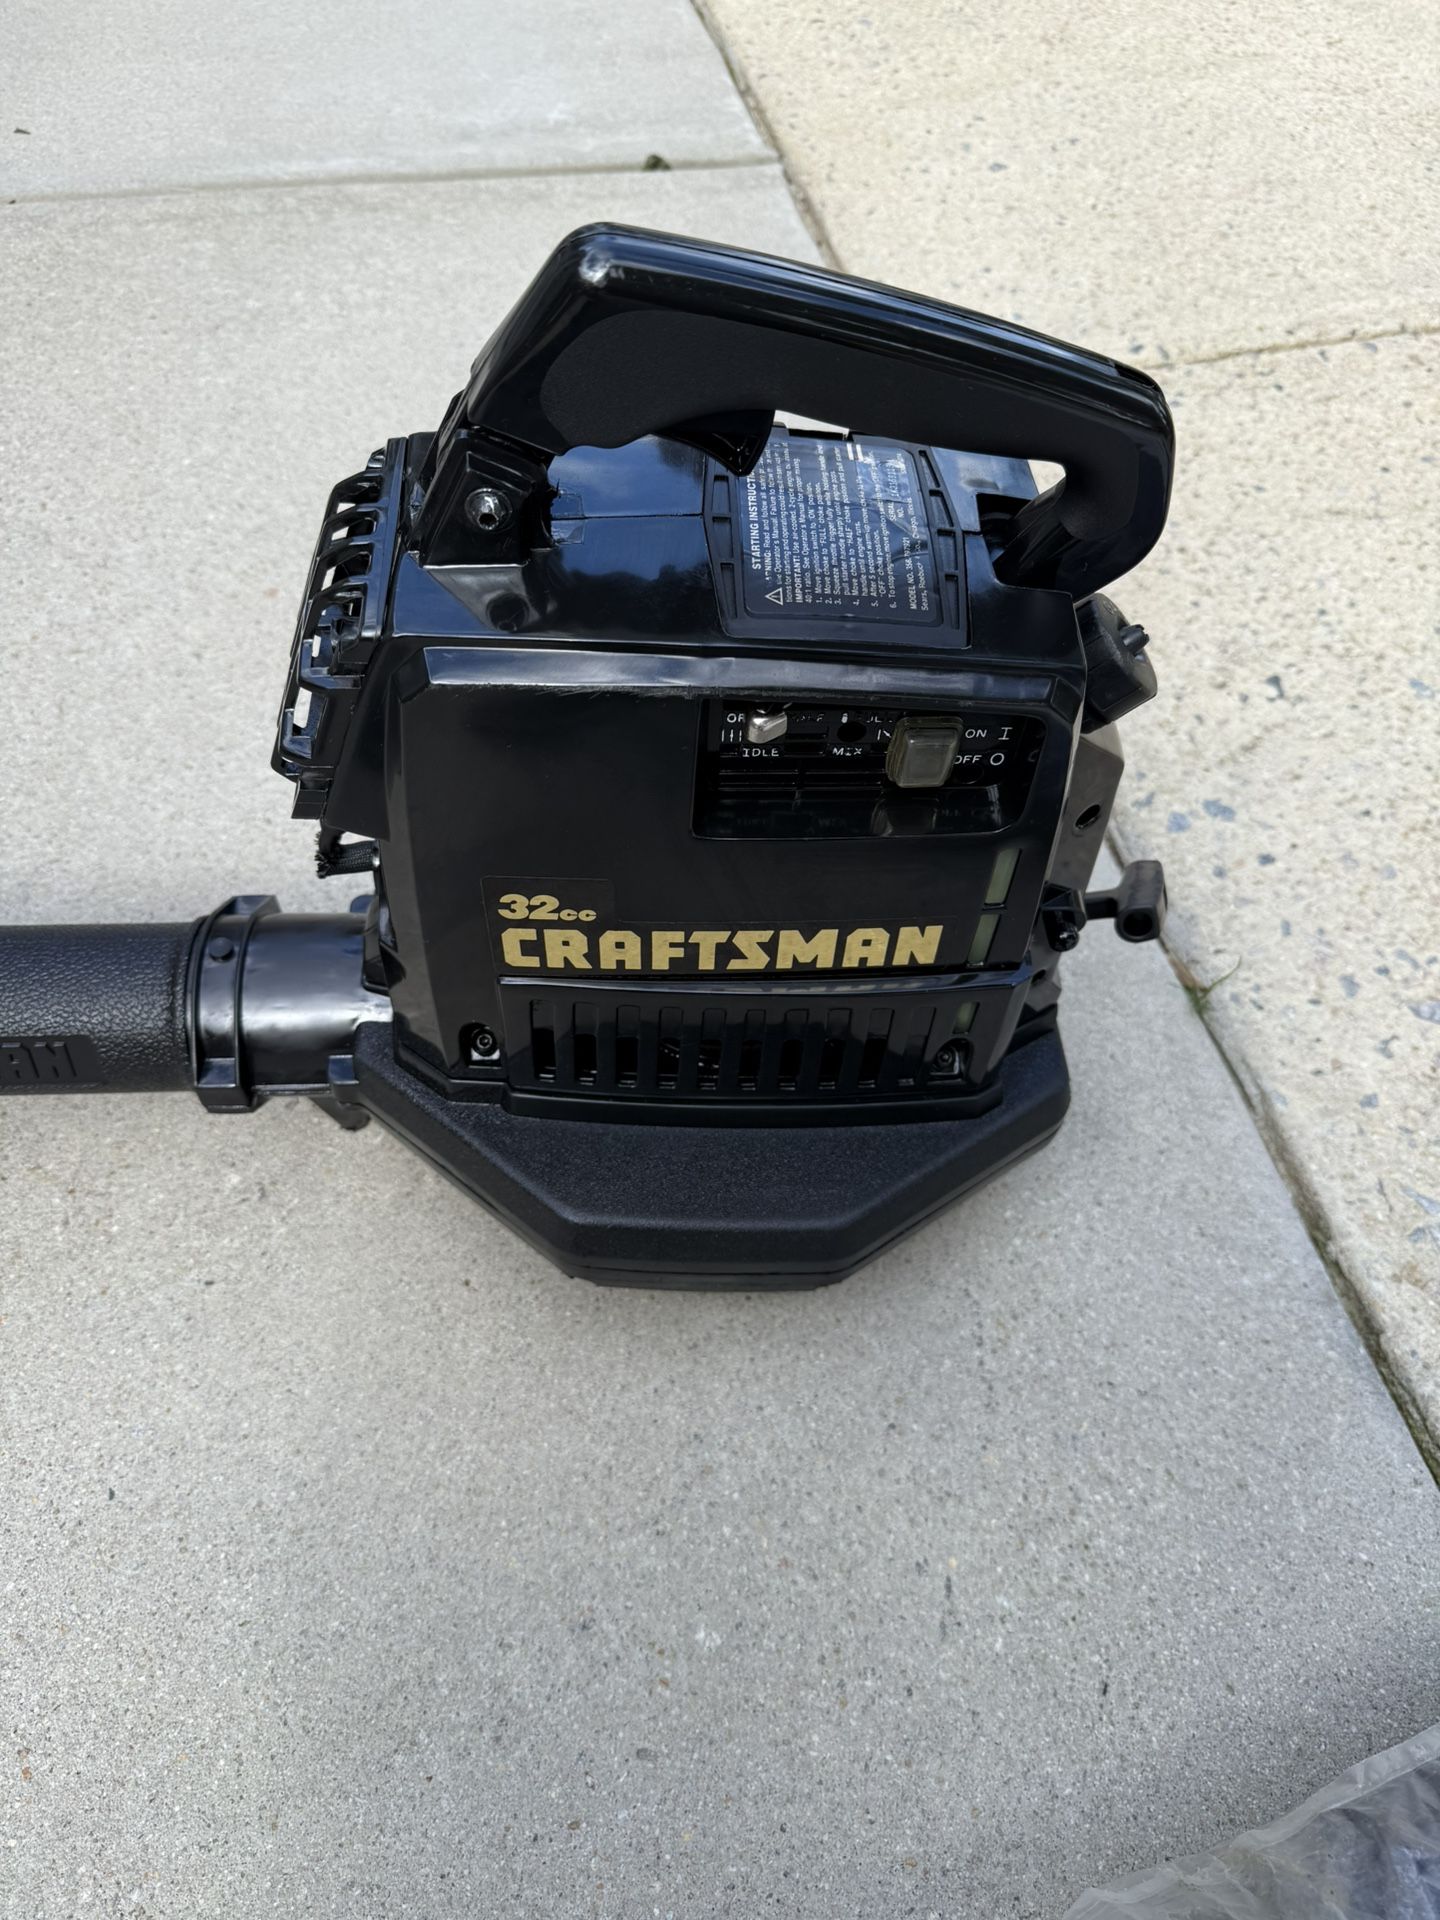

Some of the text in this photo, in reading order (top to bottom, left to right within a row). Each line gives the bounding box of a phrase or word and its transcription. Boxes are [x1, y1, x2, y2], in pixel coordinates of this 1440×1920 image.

[768, 496, 777, 515] Failure
[826, 507, 834, 520] fully
[896, 507, 904, 518] NO.
[828, 522, 836, 541] trigger
[836, 516, 845, 537] sharply
[750, 523, 761, 569] STARTING
[801, 524, 810, 556] Operator's
[810, 529, 819, 550] switch
[857, 537, 866, 557] engine
[772, 540, 782, 572] Operator's
[867, 551, 875, 573] second
[849, 557, 857, 576] choke
[793, 556, 803, 602] IMPORTANT!
[814, 576, 822, 594] Move
[833, 568, 841, 595] Squeeze
[906, 572, 915, 584] NO.
[842, 583, 851, 596] pull
[888, 590, 896, 598] To
[908, 585, 917, 609] MODEL
[965, 728, 988, 738] ON
[742, 748, 780, 758] IDLE
[832, 746, 863, 756] MIX
[954, 754, 983, 764] OFF
[497, 894, 597, 922] 32cc
[500, 925, 944, 970] CRAFTSMAN
